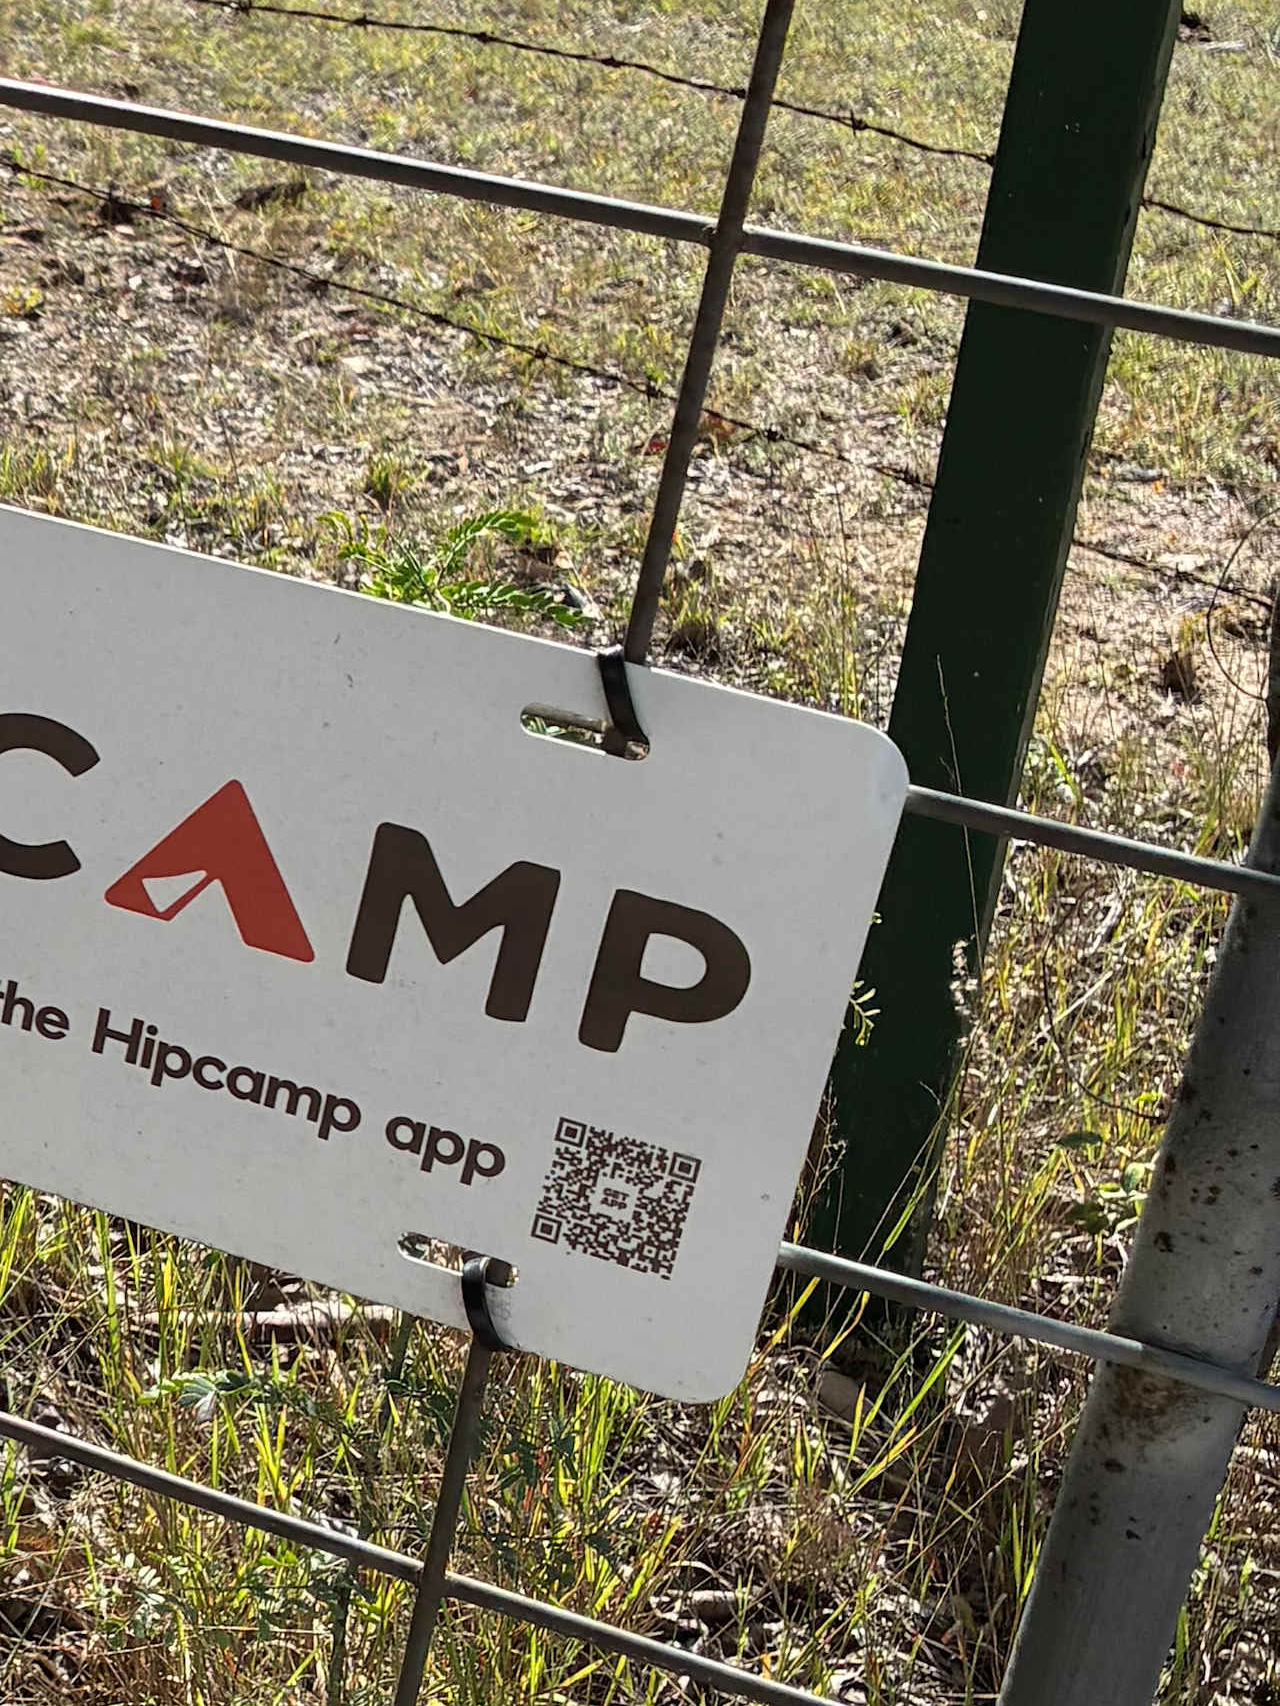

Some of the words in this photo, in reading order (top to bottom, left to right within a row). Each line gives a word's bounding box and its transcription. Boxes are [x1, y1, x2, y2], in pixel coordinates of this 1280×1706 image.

[91, 1007, 362, 1141] Hipcamp
[385, 1116, 506, 1186] app
[600, 1197, 627, 1210] APP
